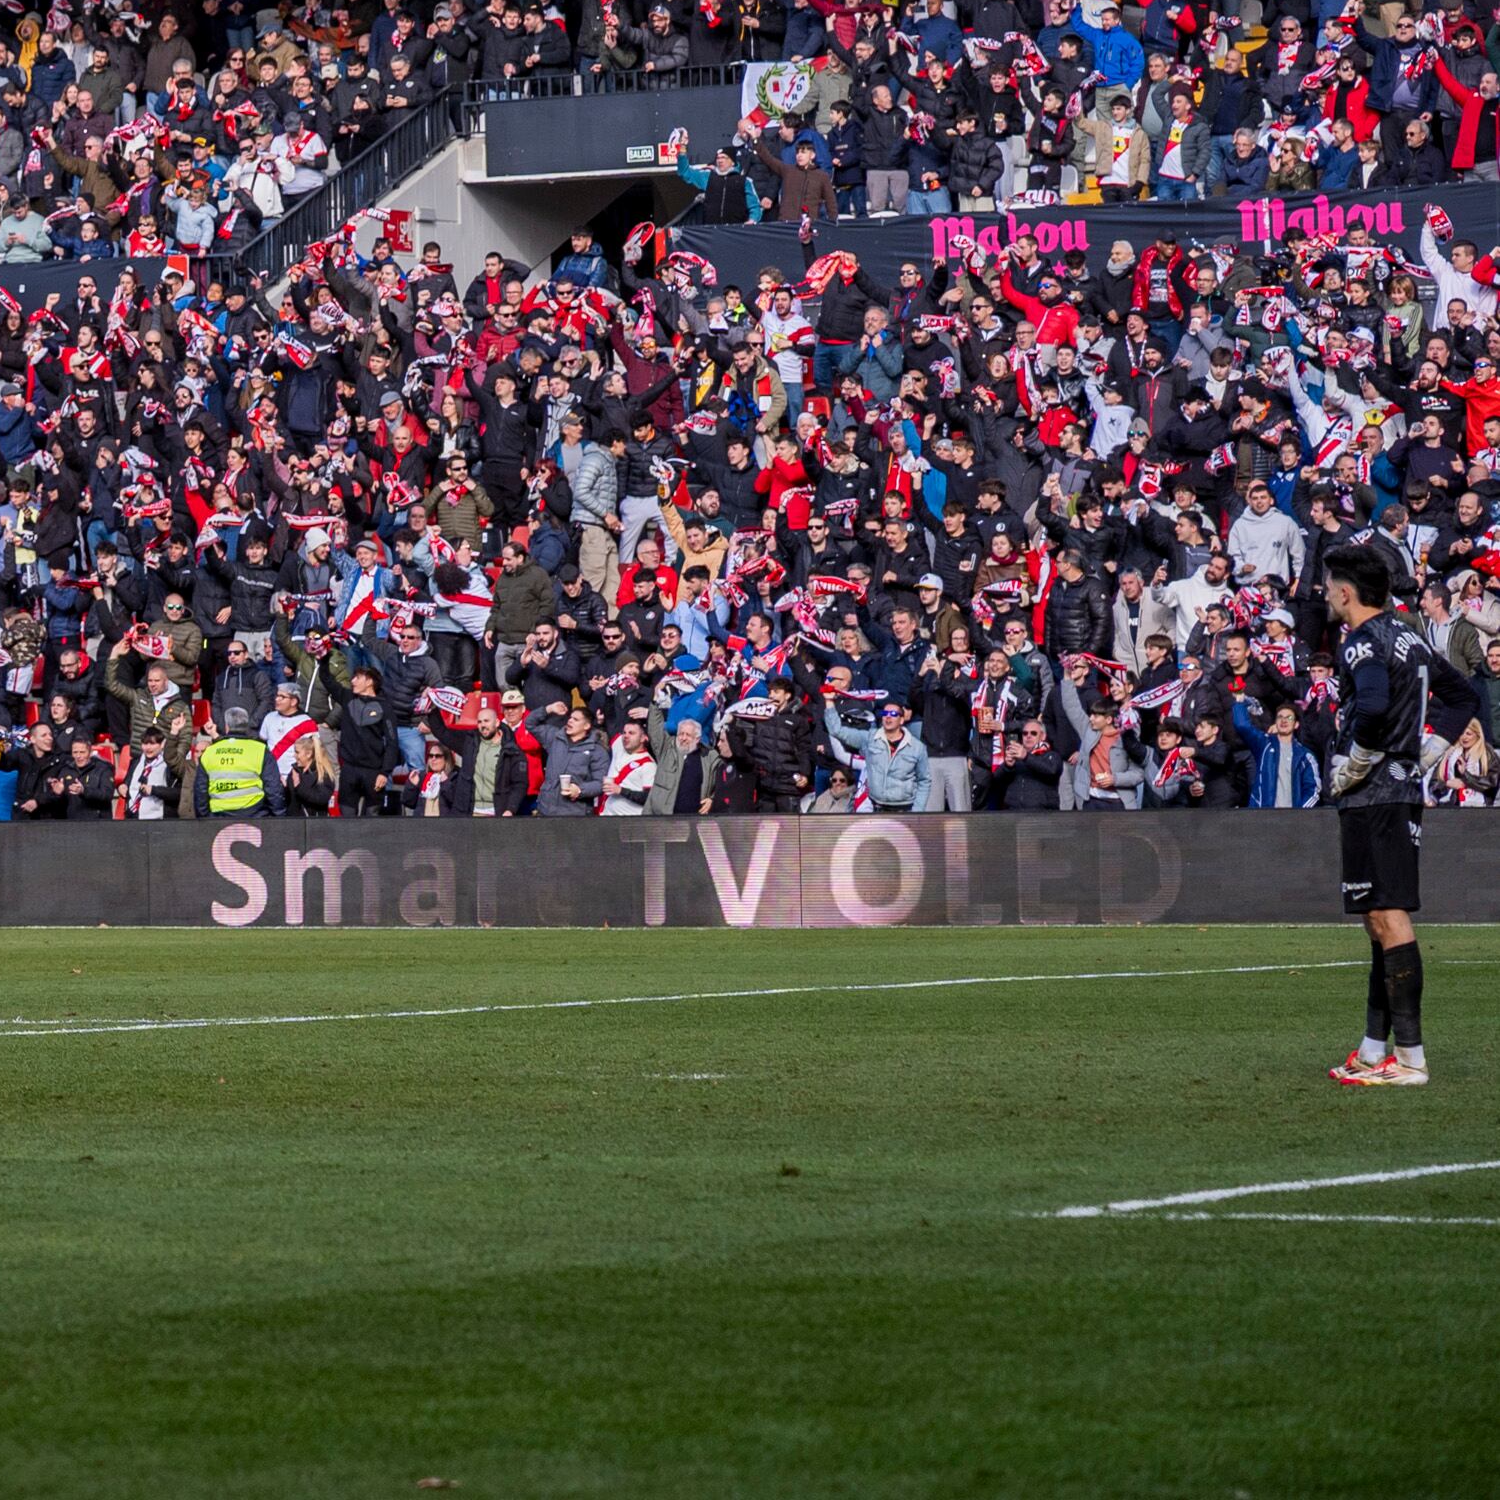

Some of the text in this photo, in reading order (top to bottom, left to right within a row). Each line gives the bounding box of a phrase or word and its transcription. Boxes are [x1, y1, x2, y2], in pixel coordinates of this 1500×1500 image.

[629, 148, 653, 159] SALIDA
[928, 211, 1090, 258] Mahou
[1238, 194, 1406, 242] Mahou
[1417, 665, 1429, 737] 1
[220, 757, 234, 765] 013
[619, 818, 1183, 926] TV OLED
